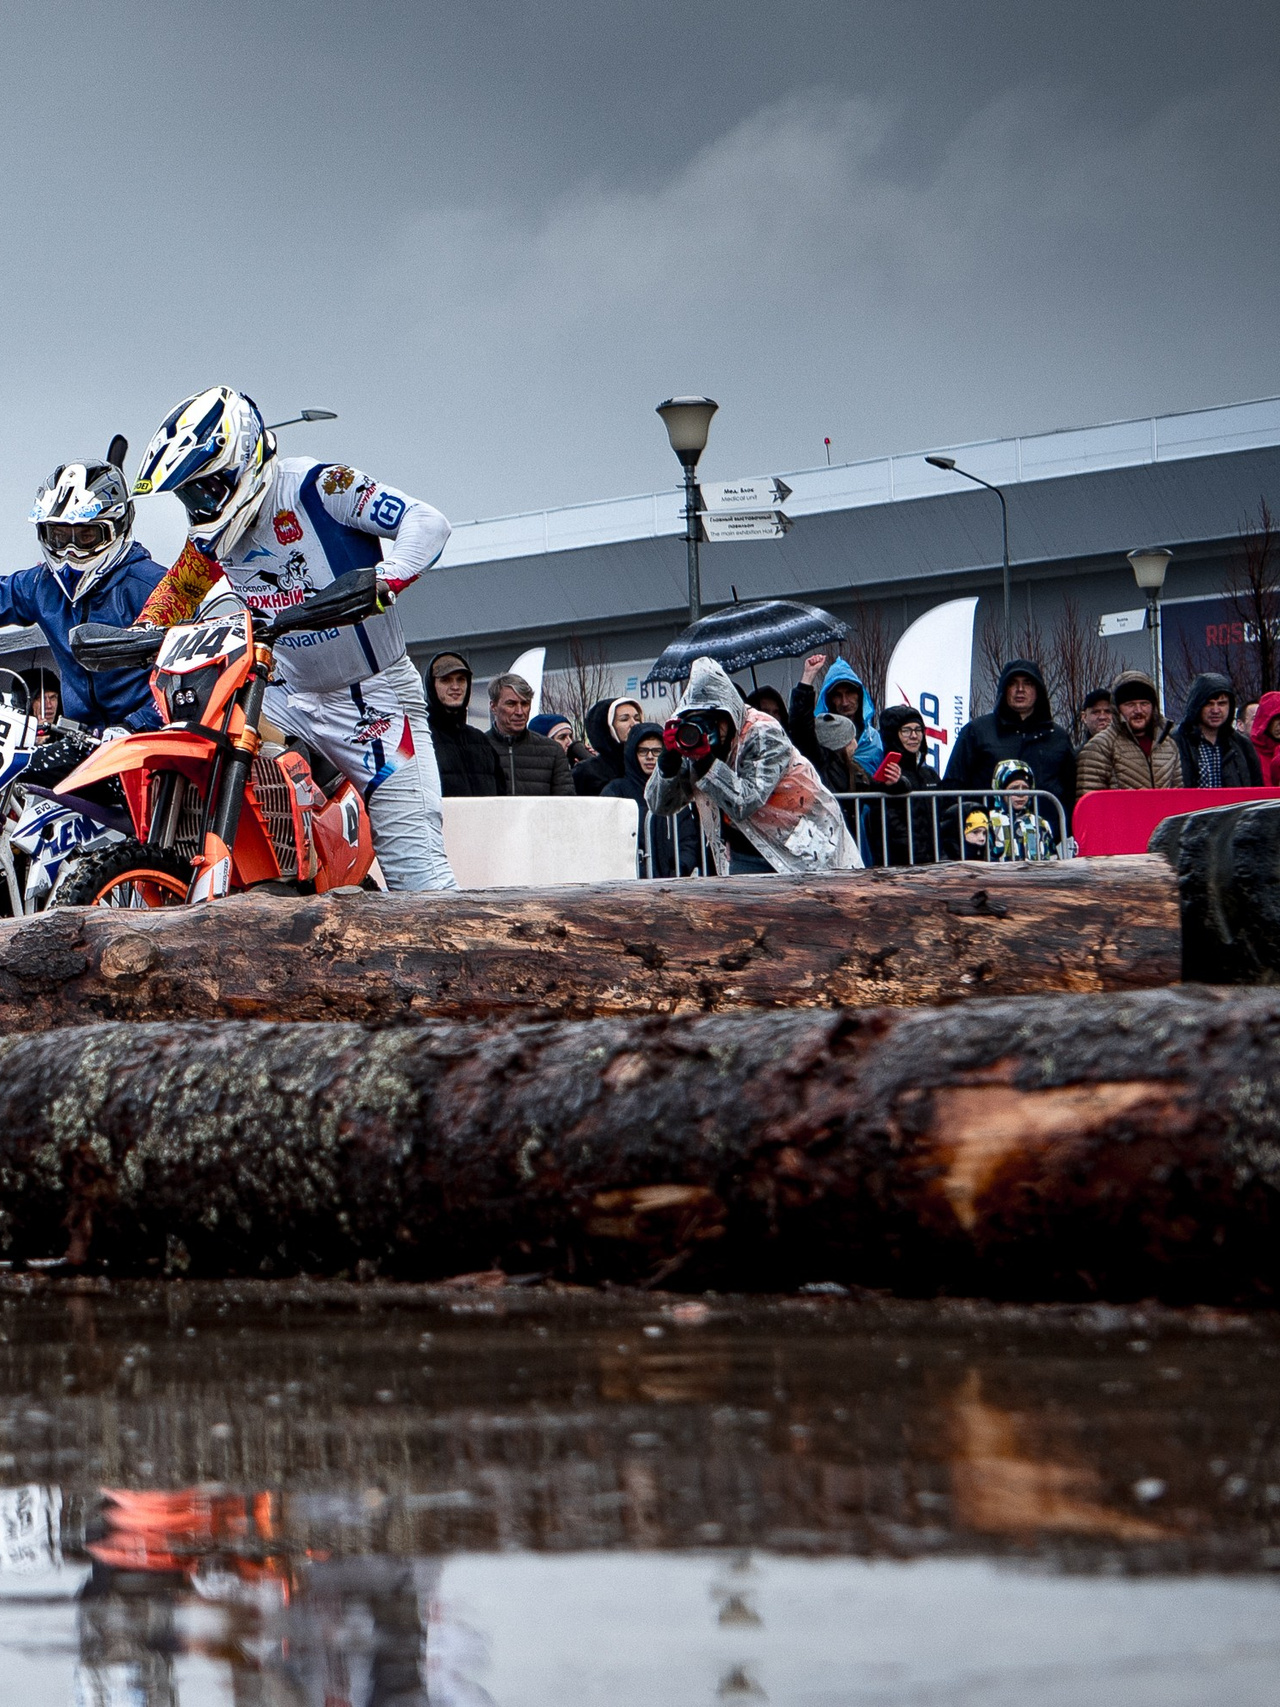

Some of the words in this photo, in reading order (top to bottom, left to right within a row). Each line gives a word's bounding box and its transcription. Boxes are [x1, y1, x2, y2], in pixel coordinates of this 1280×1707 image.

[233, 583, 272, 593] ОТОСПОРТ
[246, 585, 305, 609] ЮЖНЫЙ
[160, 626, 233, 669] 444
[277, 627, 341, 650] sqvarna
